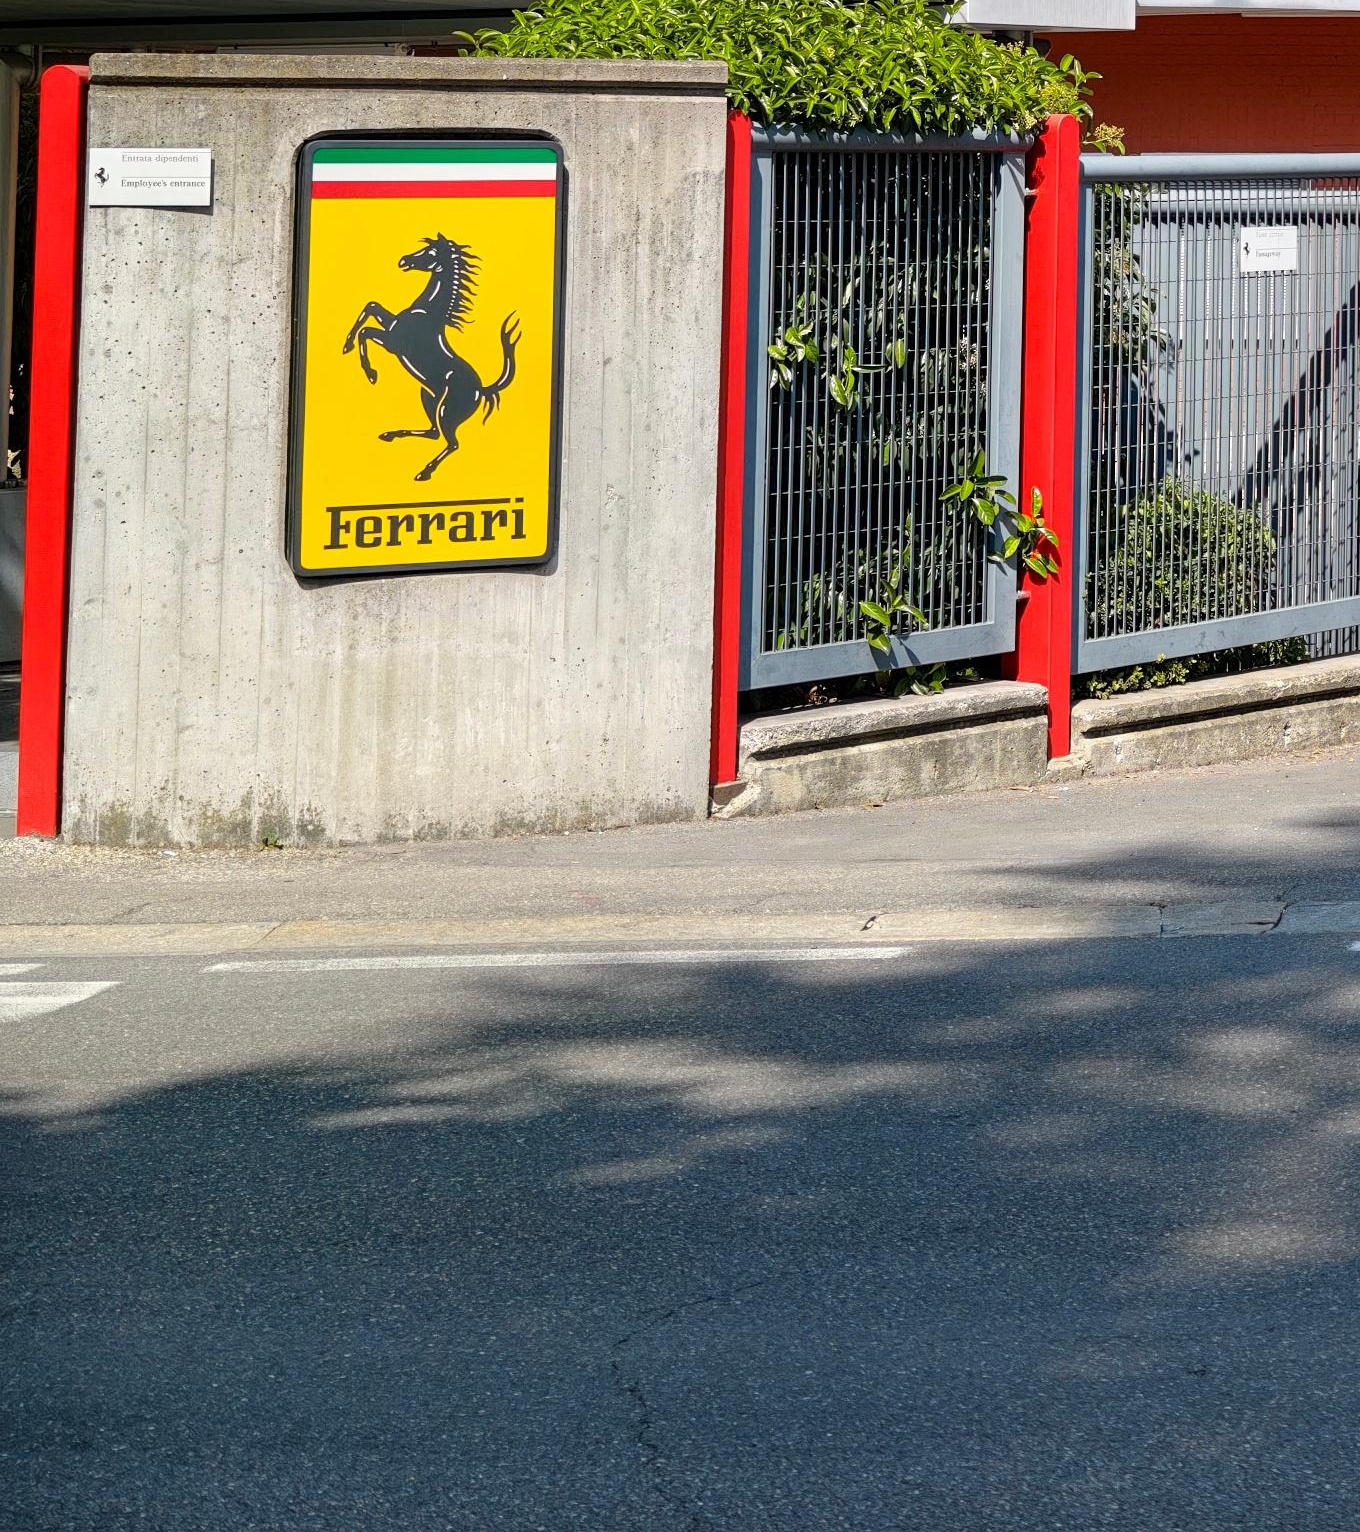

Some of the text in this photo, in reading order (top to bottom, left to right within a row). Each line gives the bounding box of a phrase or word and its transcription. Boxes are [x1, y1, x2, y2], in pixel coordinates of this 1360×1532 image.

[122, 154, 199, 164] Entrata dipendenti
[121, 179, 206, 189] Employee's entrance
[323, 497, 527, 550] Ferrari
